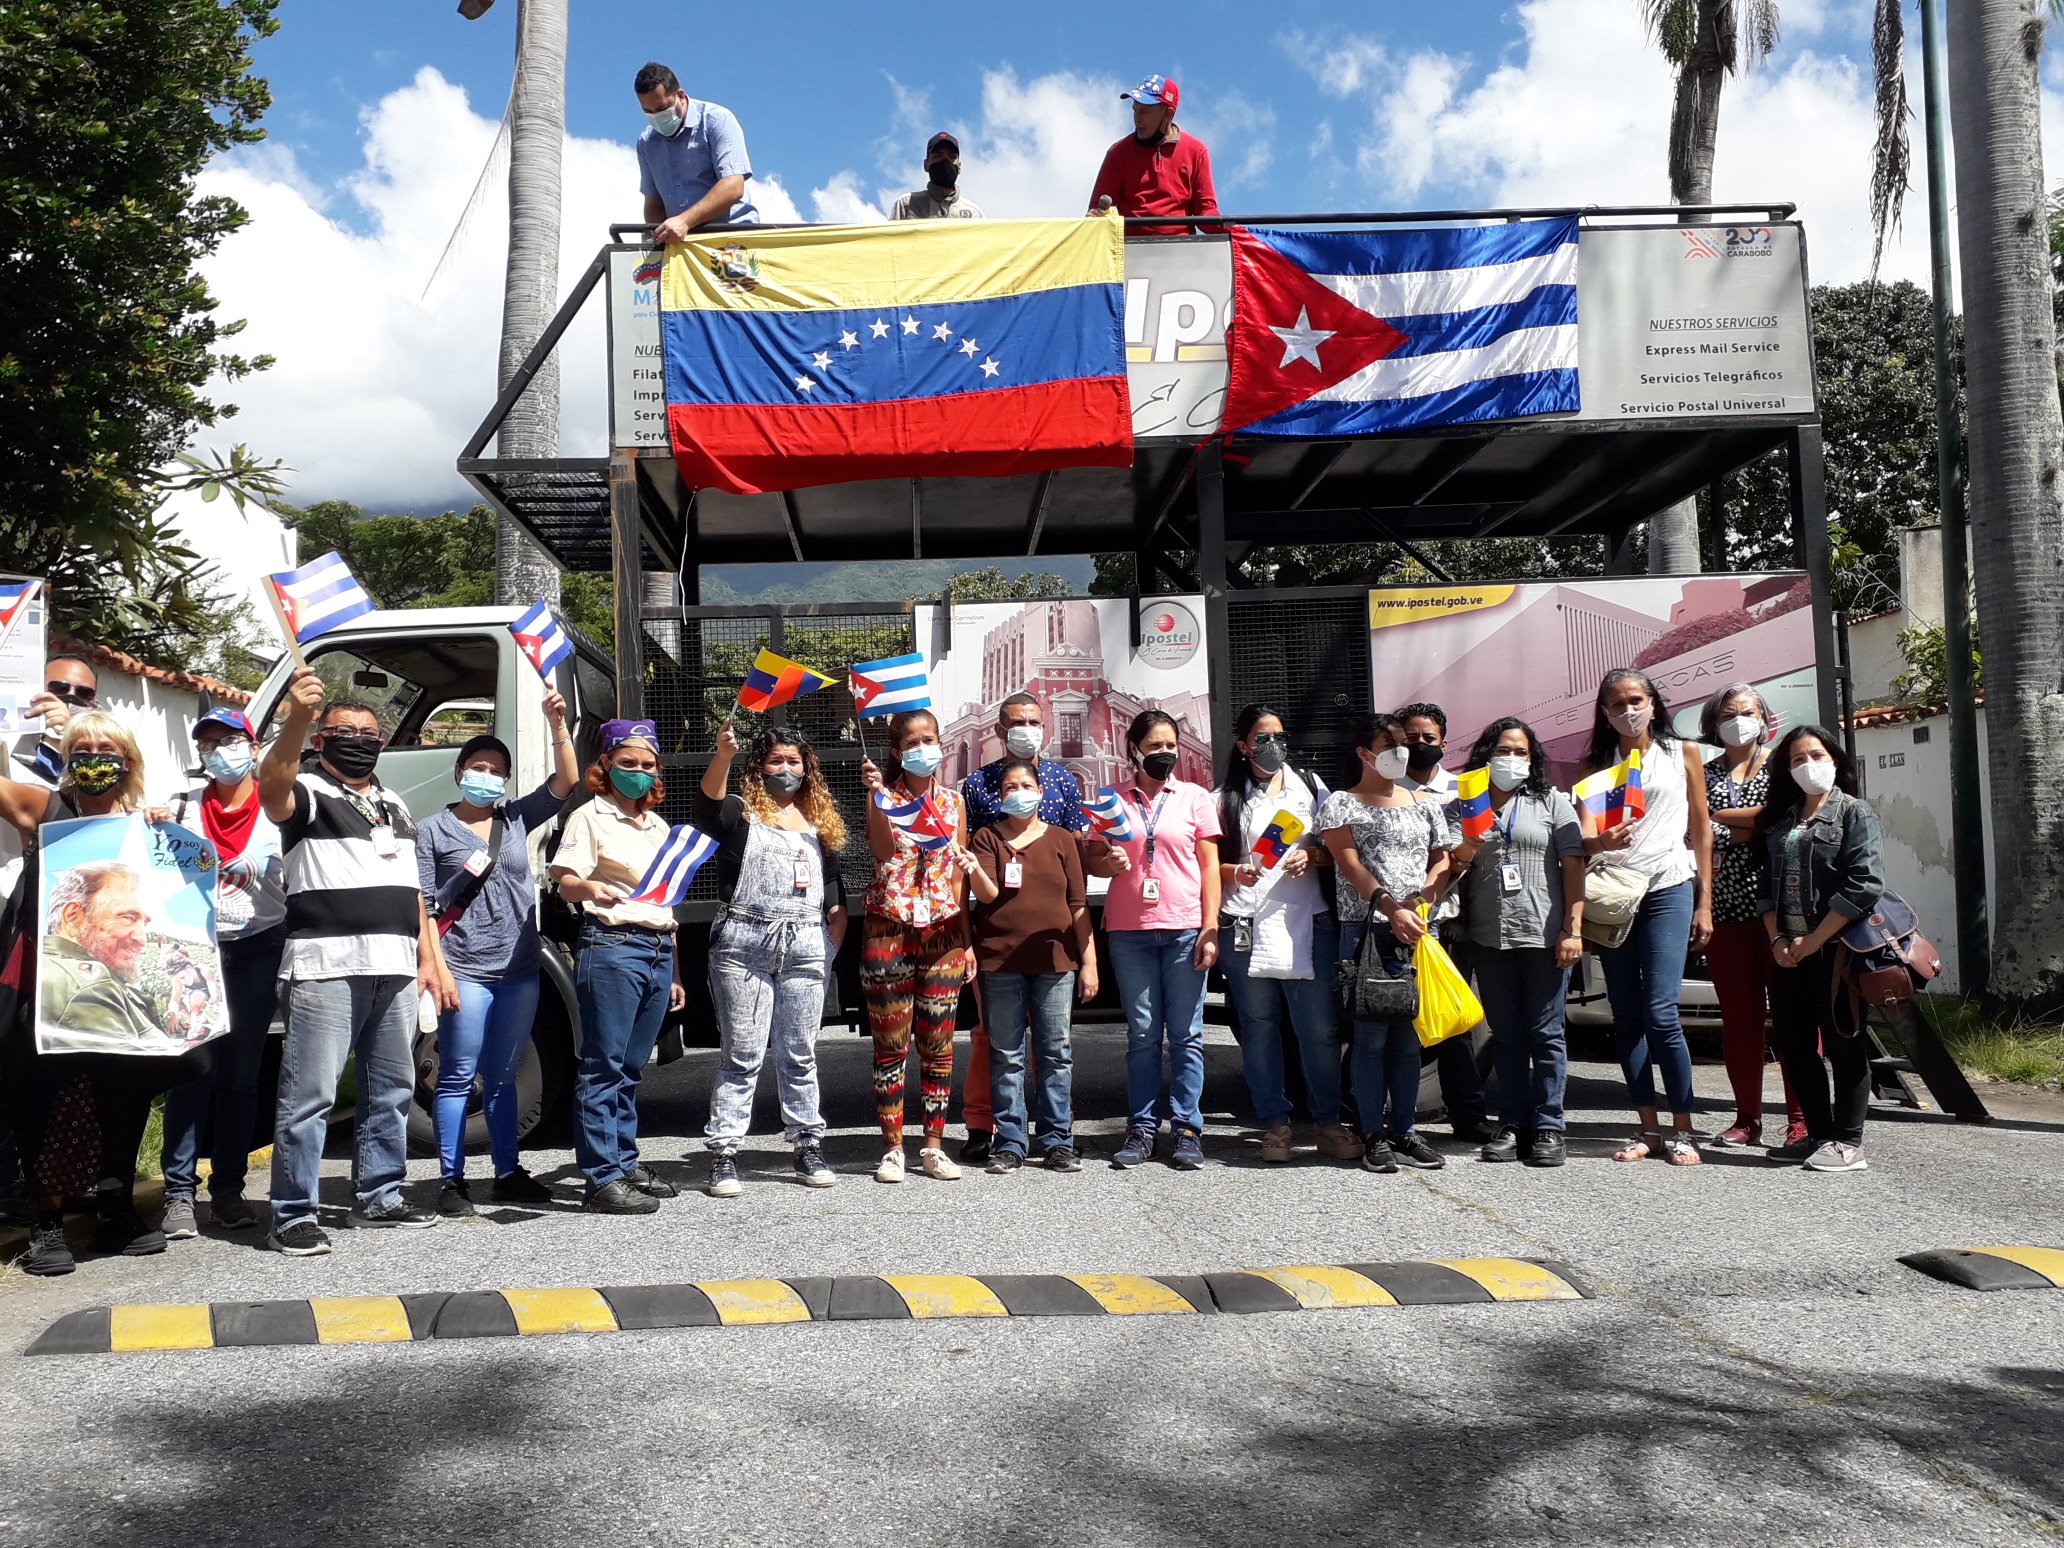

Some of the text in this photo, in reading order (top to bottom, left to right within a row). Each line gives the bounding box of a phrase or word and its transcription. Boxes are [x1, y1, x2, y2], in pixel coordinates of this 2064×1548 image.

[1125, 278, 1234, 363] Ip
[1650, 316, 1779, 330] NUESTROS SERVICIOS
[1646, 341, 1780, 357] Express Mail Service
[1640, 370, 1783, 384] Servicios Telegráficos
[1620, 398, 1786, 413] Servicio Postal Universal
[1377, 595, 1483, 609] www.ipostel.gob.ve
[1141, 631, 1192, 647] Ipostel
[152, 832, 201, 853] Yo soy
[153, 852, 193, 868] Fidel
